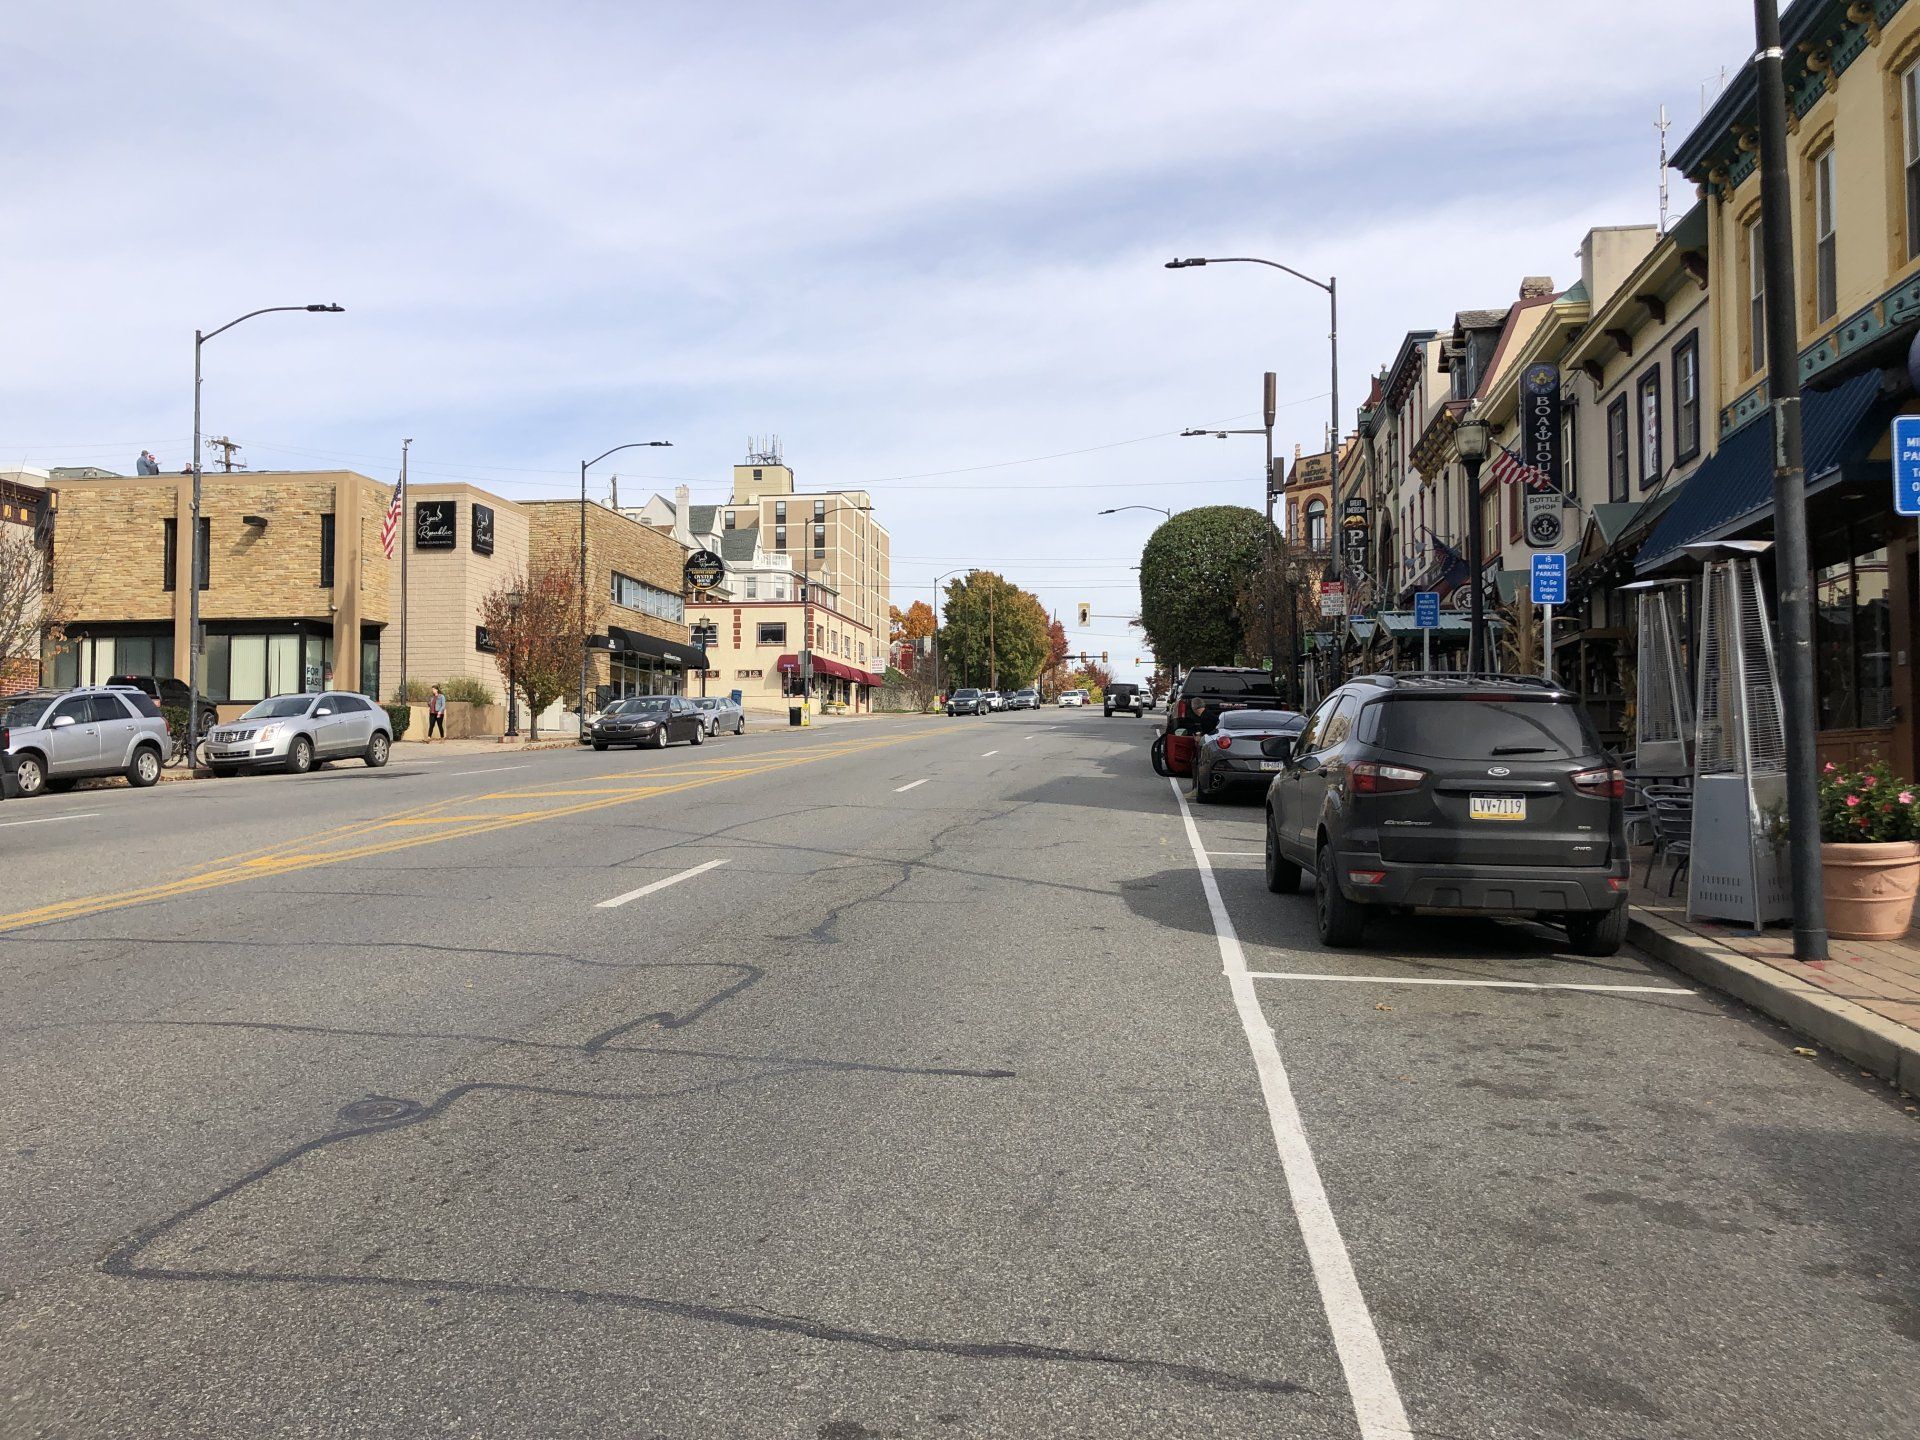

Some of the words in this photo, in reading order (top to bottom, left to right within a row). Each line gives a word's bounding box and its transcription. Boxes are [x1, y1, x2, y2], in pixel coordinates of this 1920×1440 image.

[1529, 496, 1561, 504] BOTTLE
[418, 525, 453, 539] Republic
[1347, 529, 1366, 581] PUB
[306, 667, 319, 676] FOR
